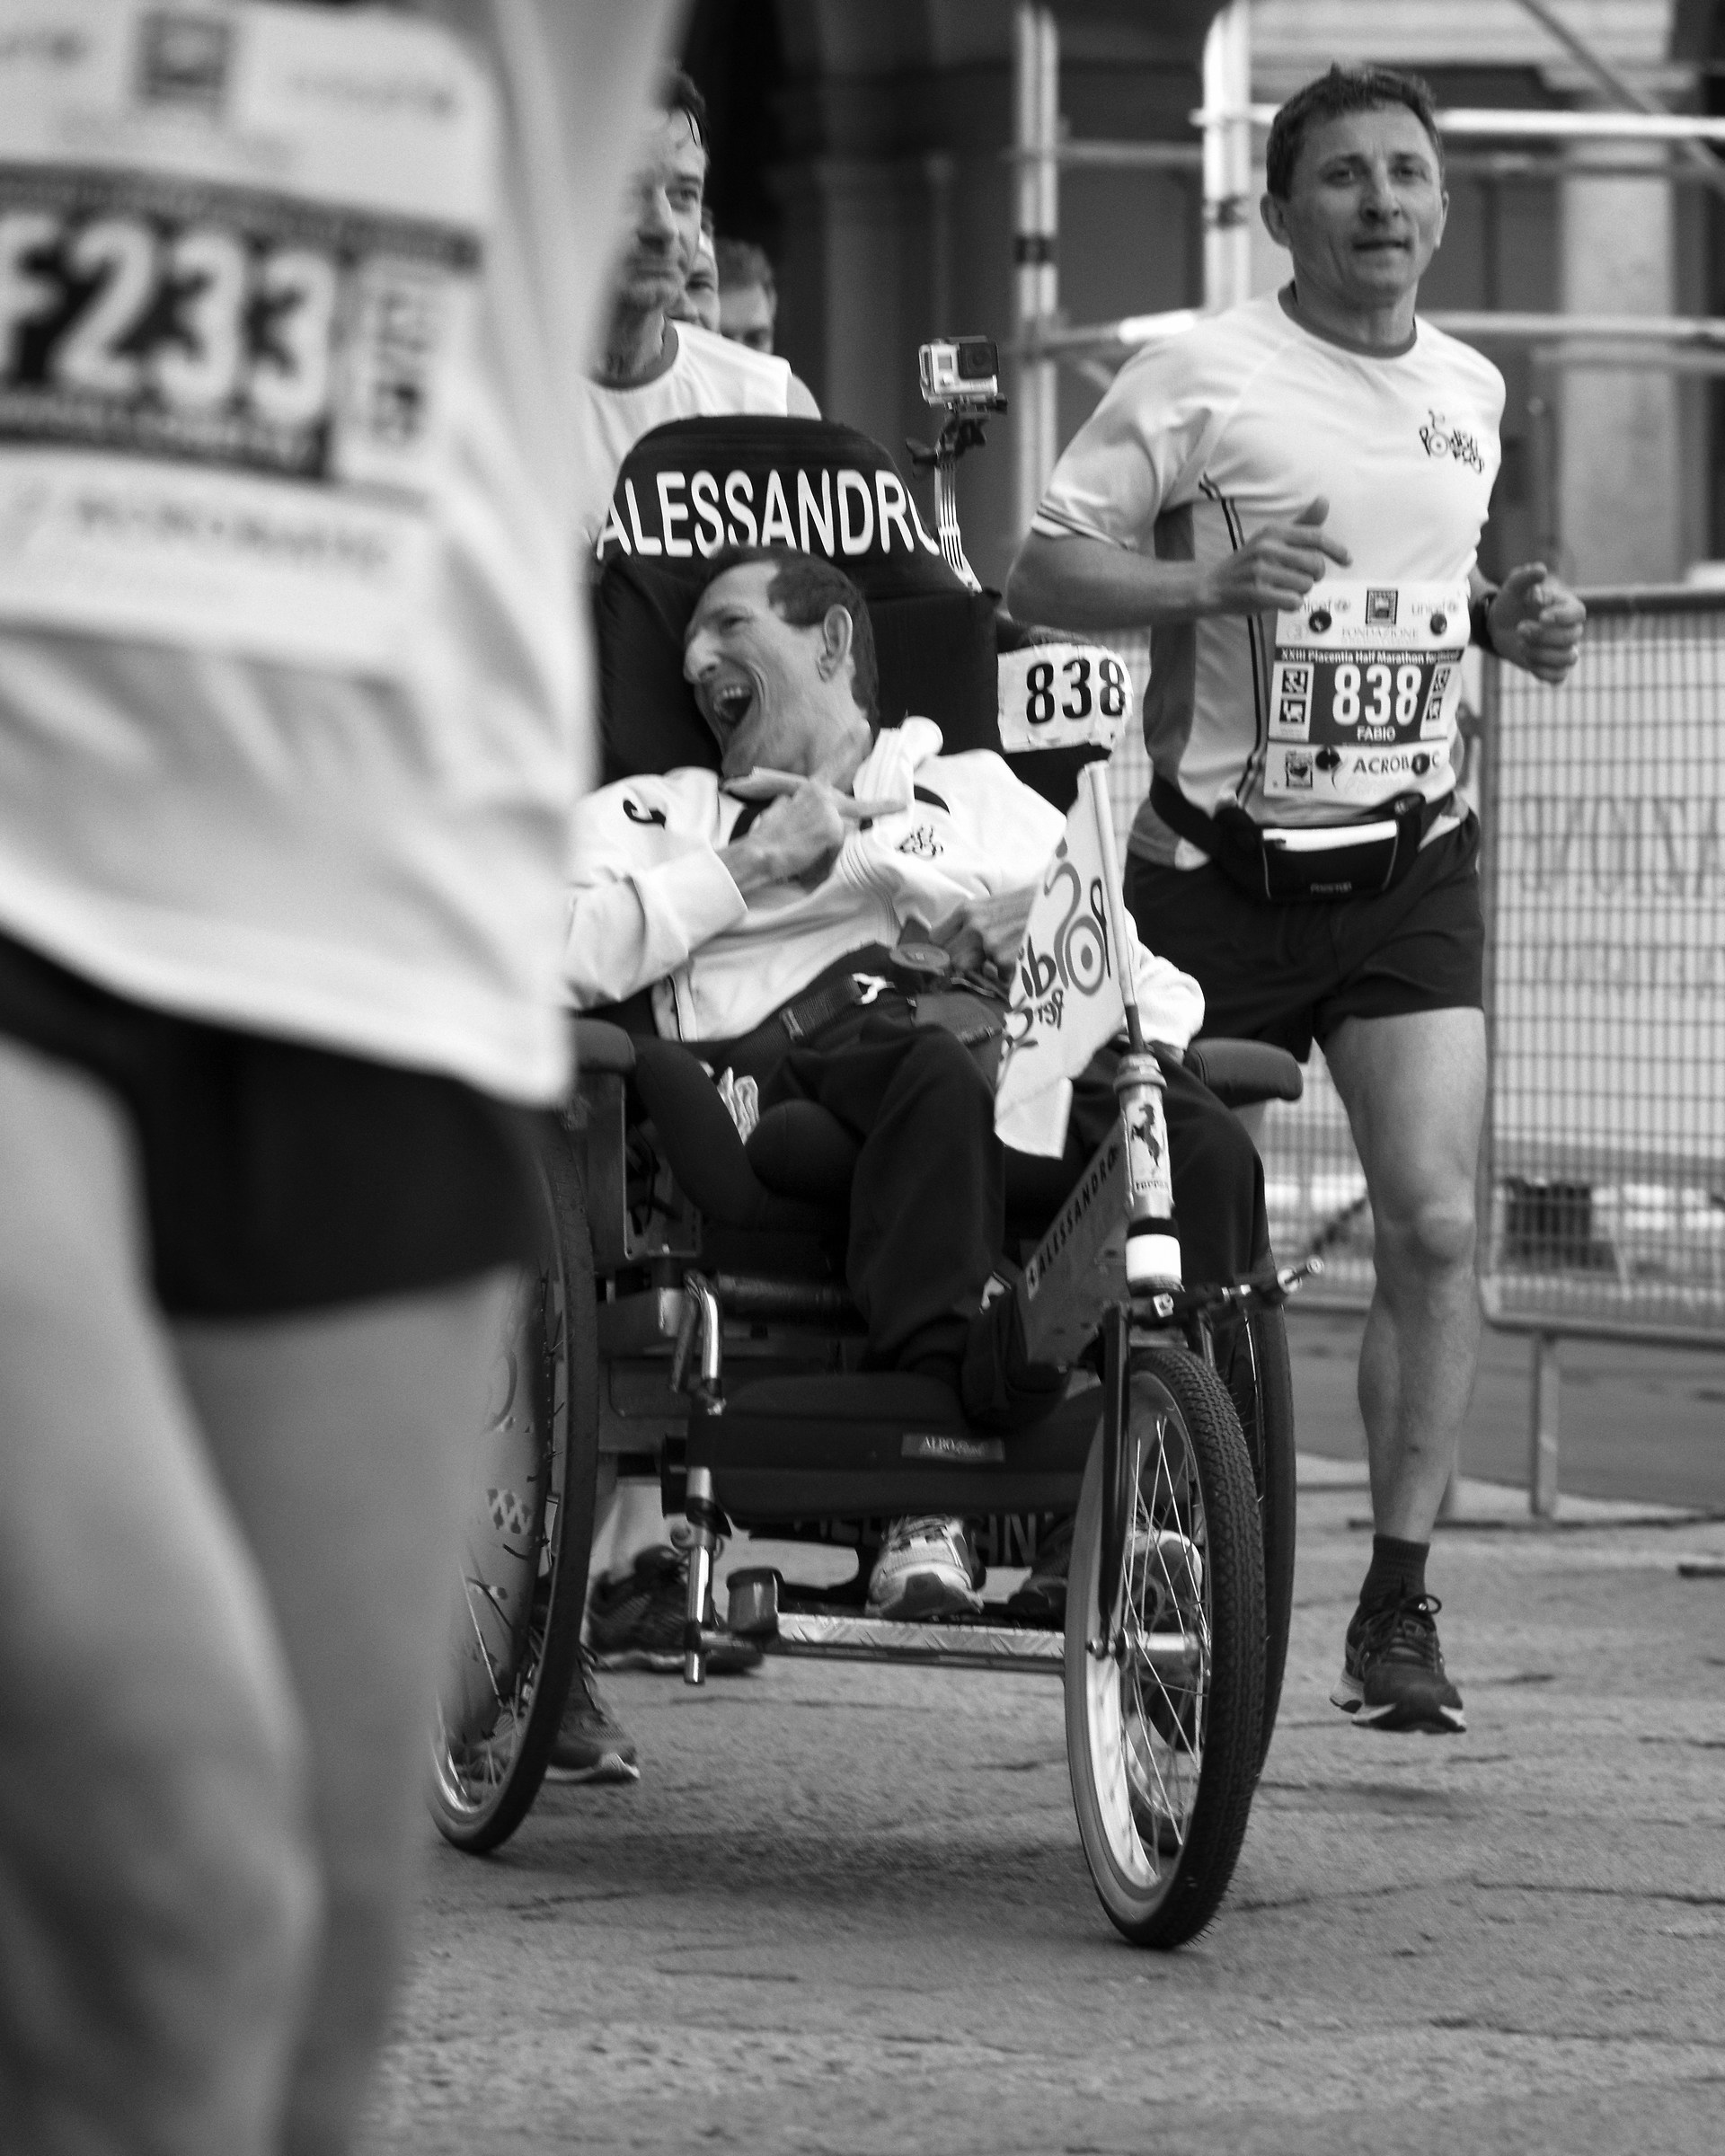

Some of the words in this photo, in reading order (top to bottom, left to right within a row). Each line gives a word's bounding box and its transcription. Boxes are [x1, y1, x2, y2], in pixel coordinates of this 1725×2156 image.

[1342, 626, 1419, 640] FONDAZIONE
[1308, 649, 1354, 663] Placentia
[1356, 649, 1376, 663] Half
[1377, 649, 1424, 664] Marathon
[1026, 658, 1125, 724] 838
[1332, 663, 1422, 727] 838
[1357, 725, 1396, 742] FABIO
[1354, 749, 1441, 775] ACROBC
